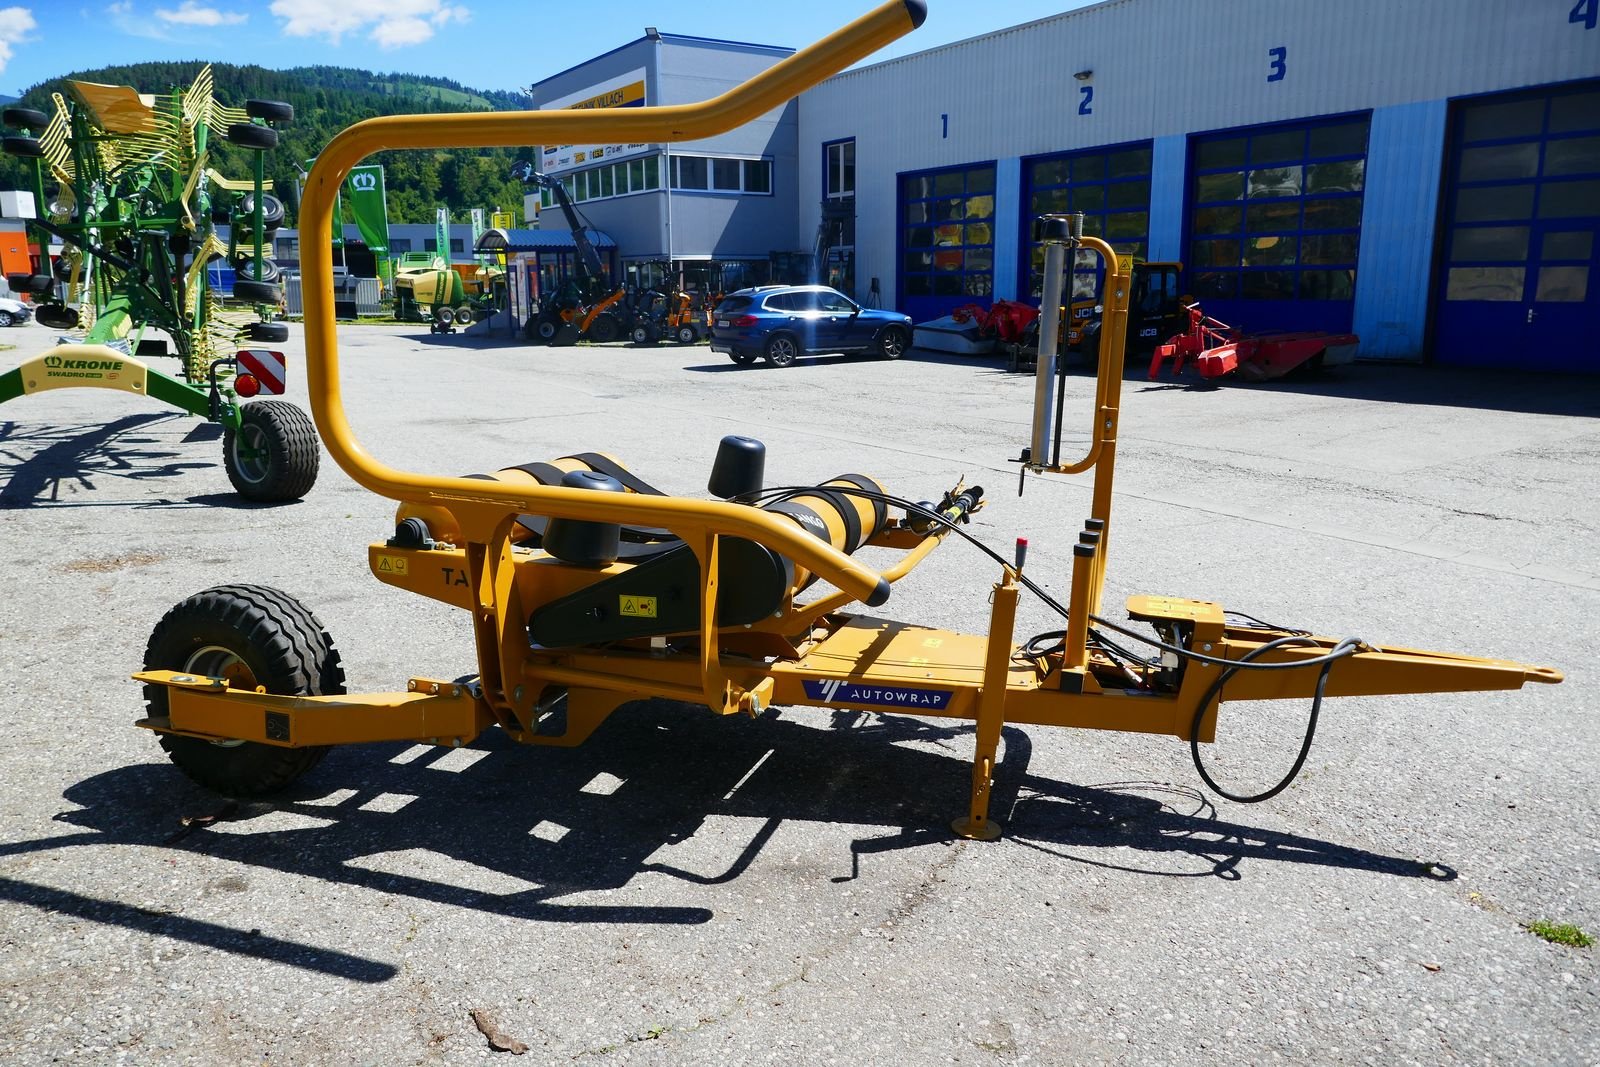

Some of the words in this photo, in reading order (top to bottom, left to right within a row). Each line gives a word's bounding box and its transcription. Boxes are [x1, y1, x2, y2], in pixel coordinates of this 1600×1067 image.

[1568, 0, 1598, 29] 4
[1267, 46, 1286, 82] 3
[597, 90, 624, 108] VILLACH
[1079, 86, 1093, 115] 2
[941, 114, 948, 138] 1
[1140, 328, 1157, 337] JCB
[63, 361, 123, 370] KRONE
[851, 690, 941, 704] AUTOWRAP
